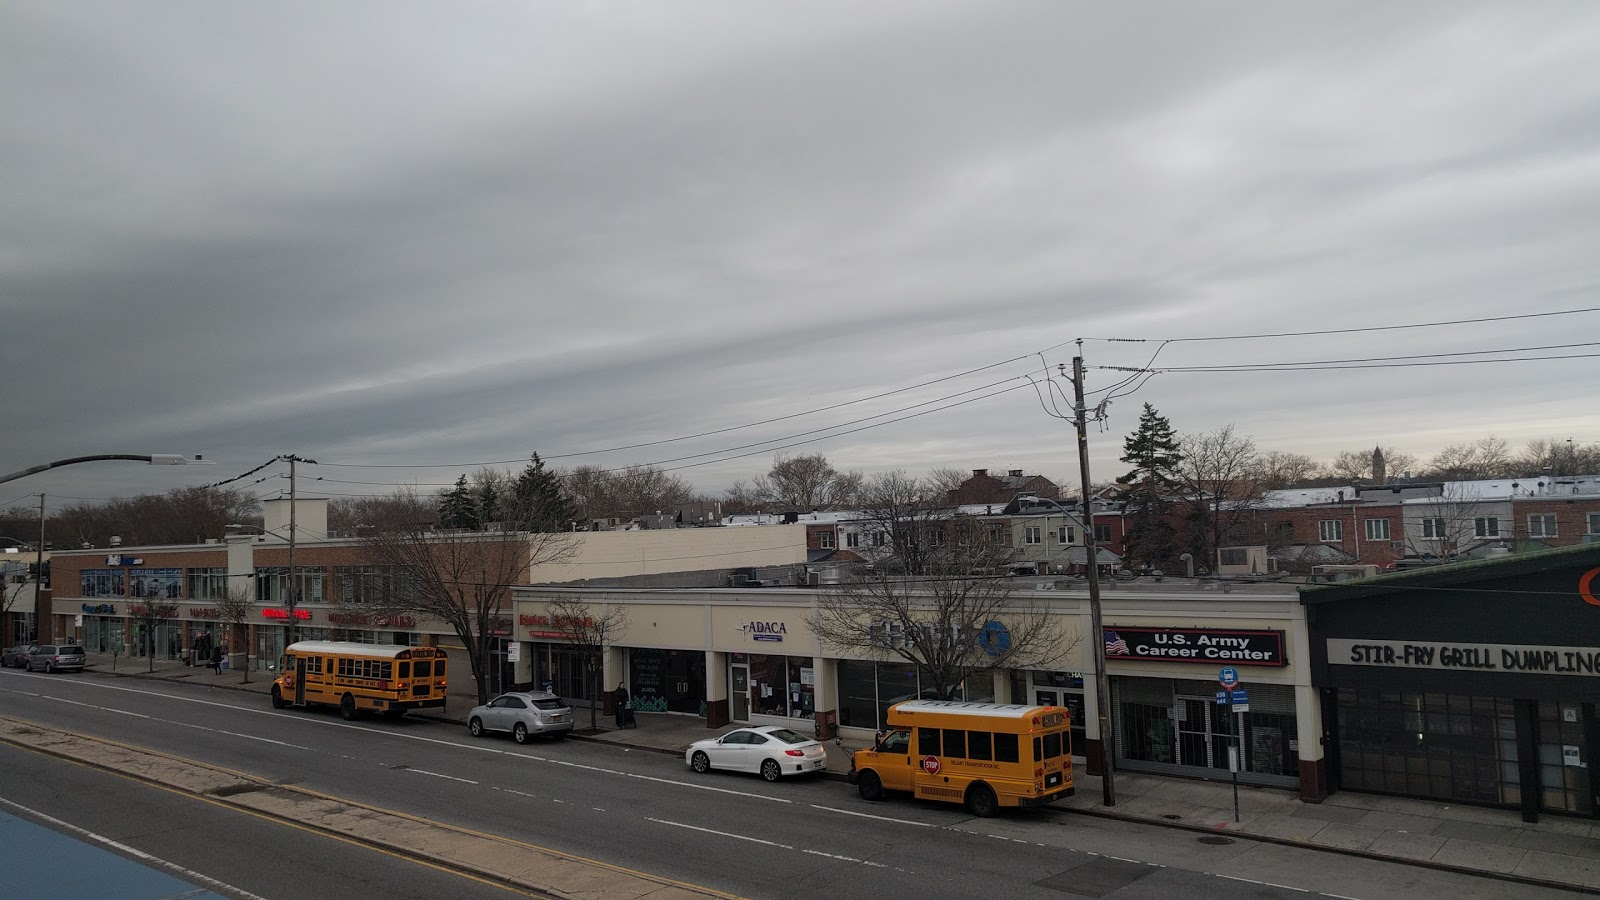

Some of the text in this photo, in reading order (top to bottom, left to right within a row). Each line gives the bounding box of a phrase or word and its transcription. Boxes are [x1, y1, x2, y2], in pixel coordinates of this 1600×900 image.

[388, 615, 412, 627] NAILS
[749, 621, 787, 634] ADACA
[1154, 633, 1250, 650] U.S. Army
[1135, 645, 1273, 661] Career Center
[1350, 644, 1435, 665] STIR-FRY
[1439, 646, 1496, 669] GRILL
[1566, 711, 1575, 719] A
[925, 760, 939, 770] STOP
